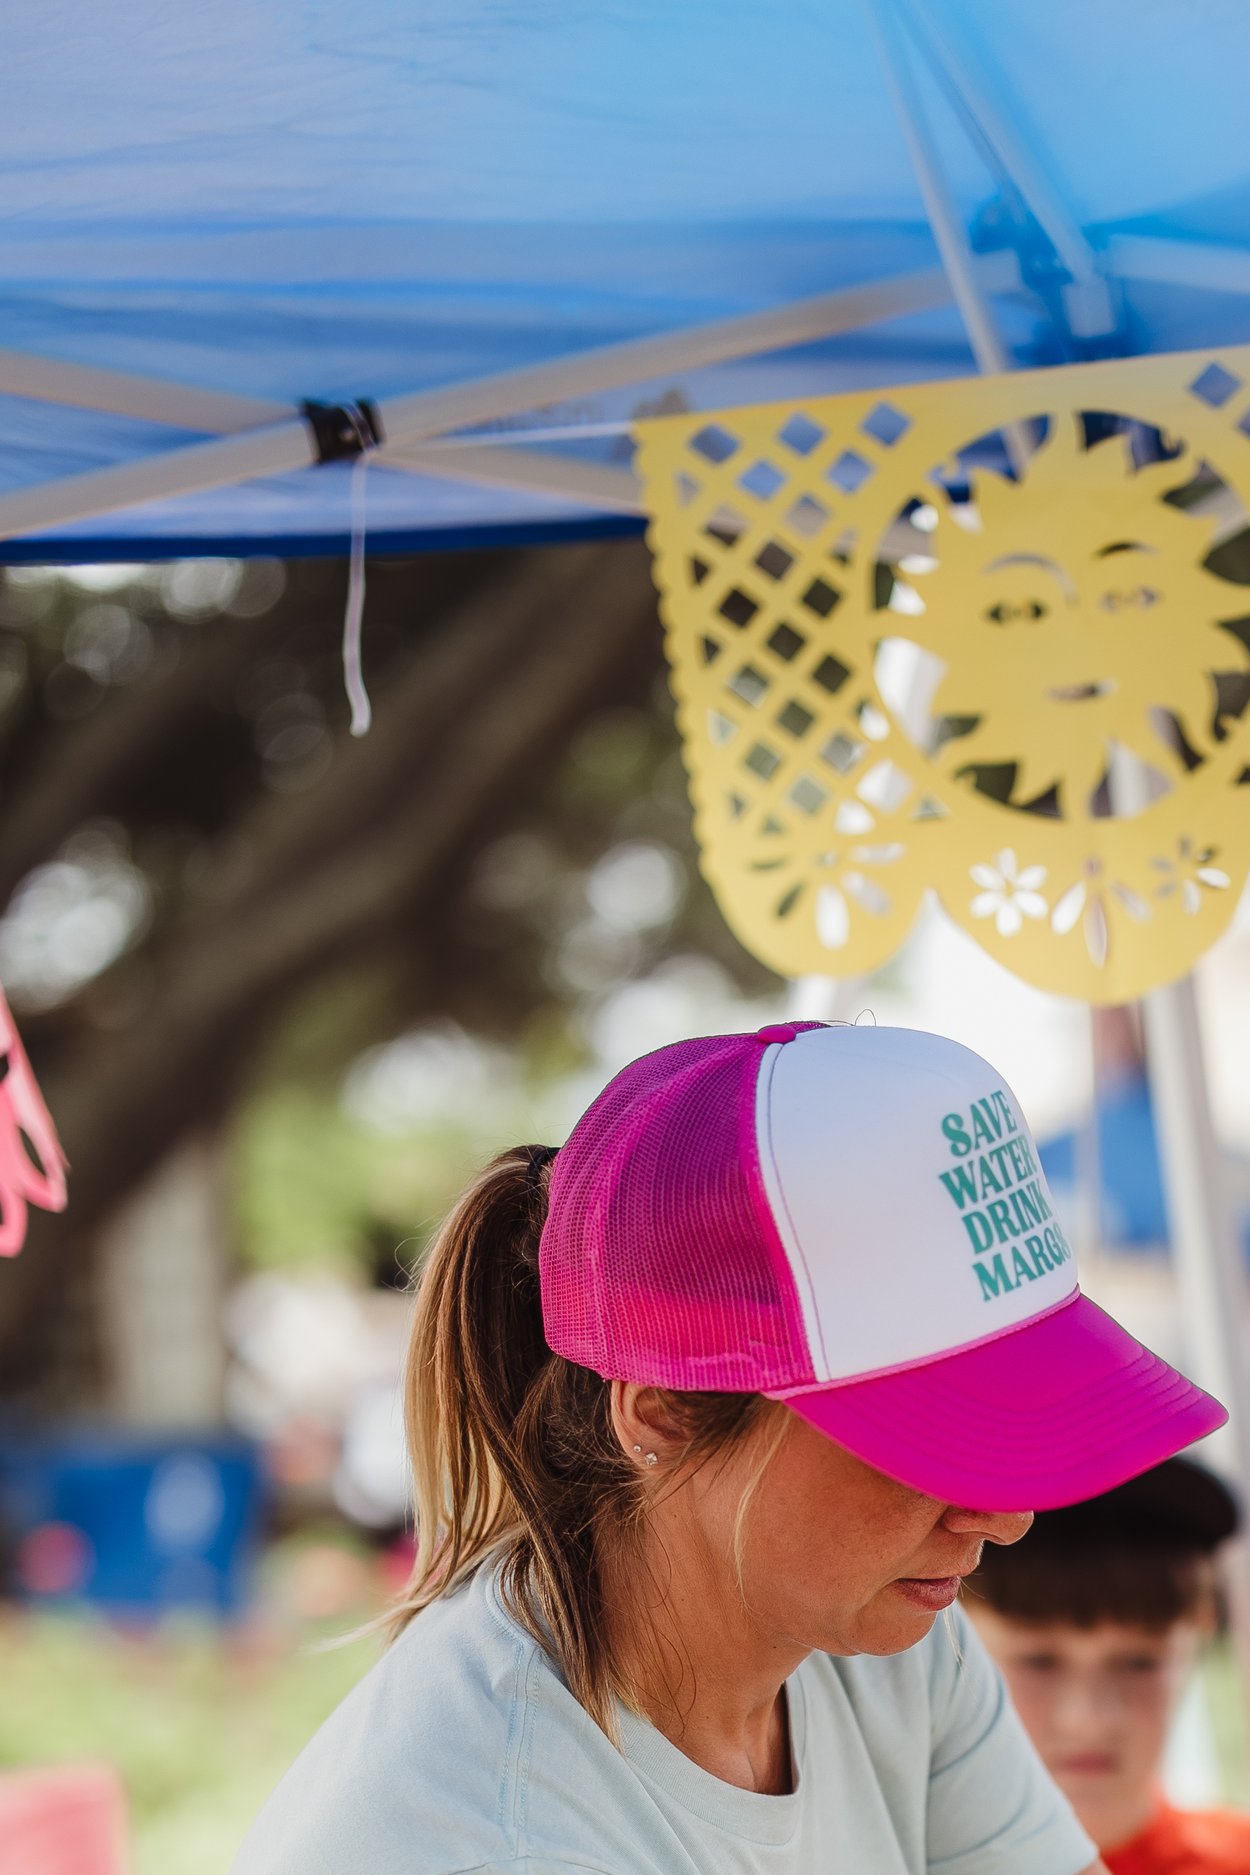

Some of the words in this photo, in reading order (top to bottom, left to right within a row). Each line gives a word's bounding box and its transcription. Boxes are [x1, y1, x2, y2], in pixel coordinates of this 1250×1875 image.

[941, 1089, 1018, 1157] SAVE
[938, 1133, 1038, 1210] WATER
[961, 1178, 1053, 1254] DRINK
